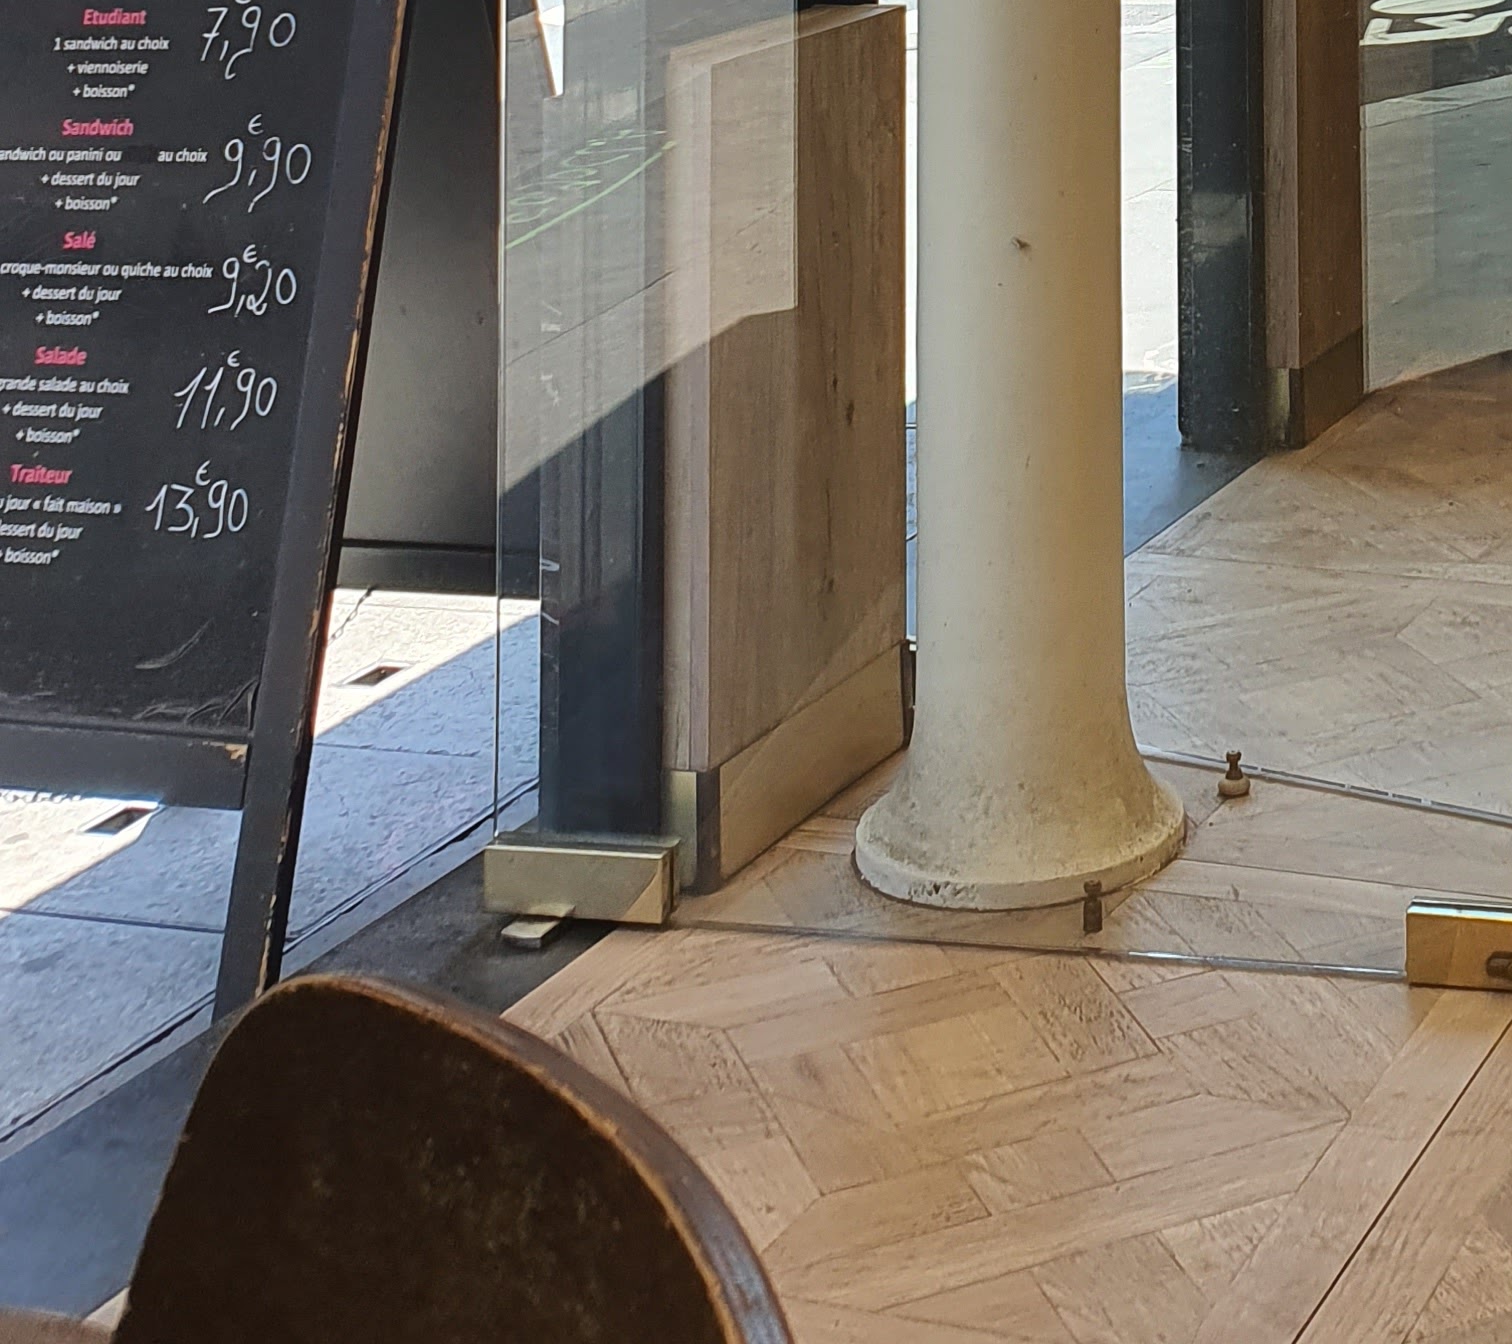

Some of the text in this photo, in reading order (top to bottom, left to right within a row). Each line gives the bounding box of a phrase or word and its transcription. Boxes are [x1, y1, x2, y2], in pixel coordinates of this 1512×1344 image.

[82, 9, 147, 26] Etudiant
[63, 35, 117, 50] sandwich
[120, 39, 136, 50] au
[137, 36, 170, 50] choix
[77, 61, 149, 75] viennoiserie
[61, 118, 134, 136] Sandwich
[48, 150, 65, 162] ou
[66, 148, 103, 164] panini
[105, 150, 122, 162] ou
[157, 151, 174, 162] au
[175, 148, 208, 163] choix
[51, 172, 140, 189] dessert du jour
[62, 231, 97, 250] Salé
[103, 265, 119, 277] ou
[121, 263, 161, 279] quiche
[163, 267, 179, 278] au
[181, 263, 213, 278] choix
[32, 286, 122, 304] dessert du jour
[34, 346, 88, 366] Salade
[38, 376, 77, 393] salade
[79, 380, 95, 393] au
[96, 378, 130, 394] choix
[12, 402, 104, 421] dessert du jour
[10, 463, 73, 484] Traiteur
[43, 496, 65, 512] fait
[66, 499, 111, 514] maison
[37, 521, 55, 539] du
[54, 523, 84, 542] jour
